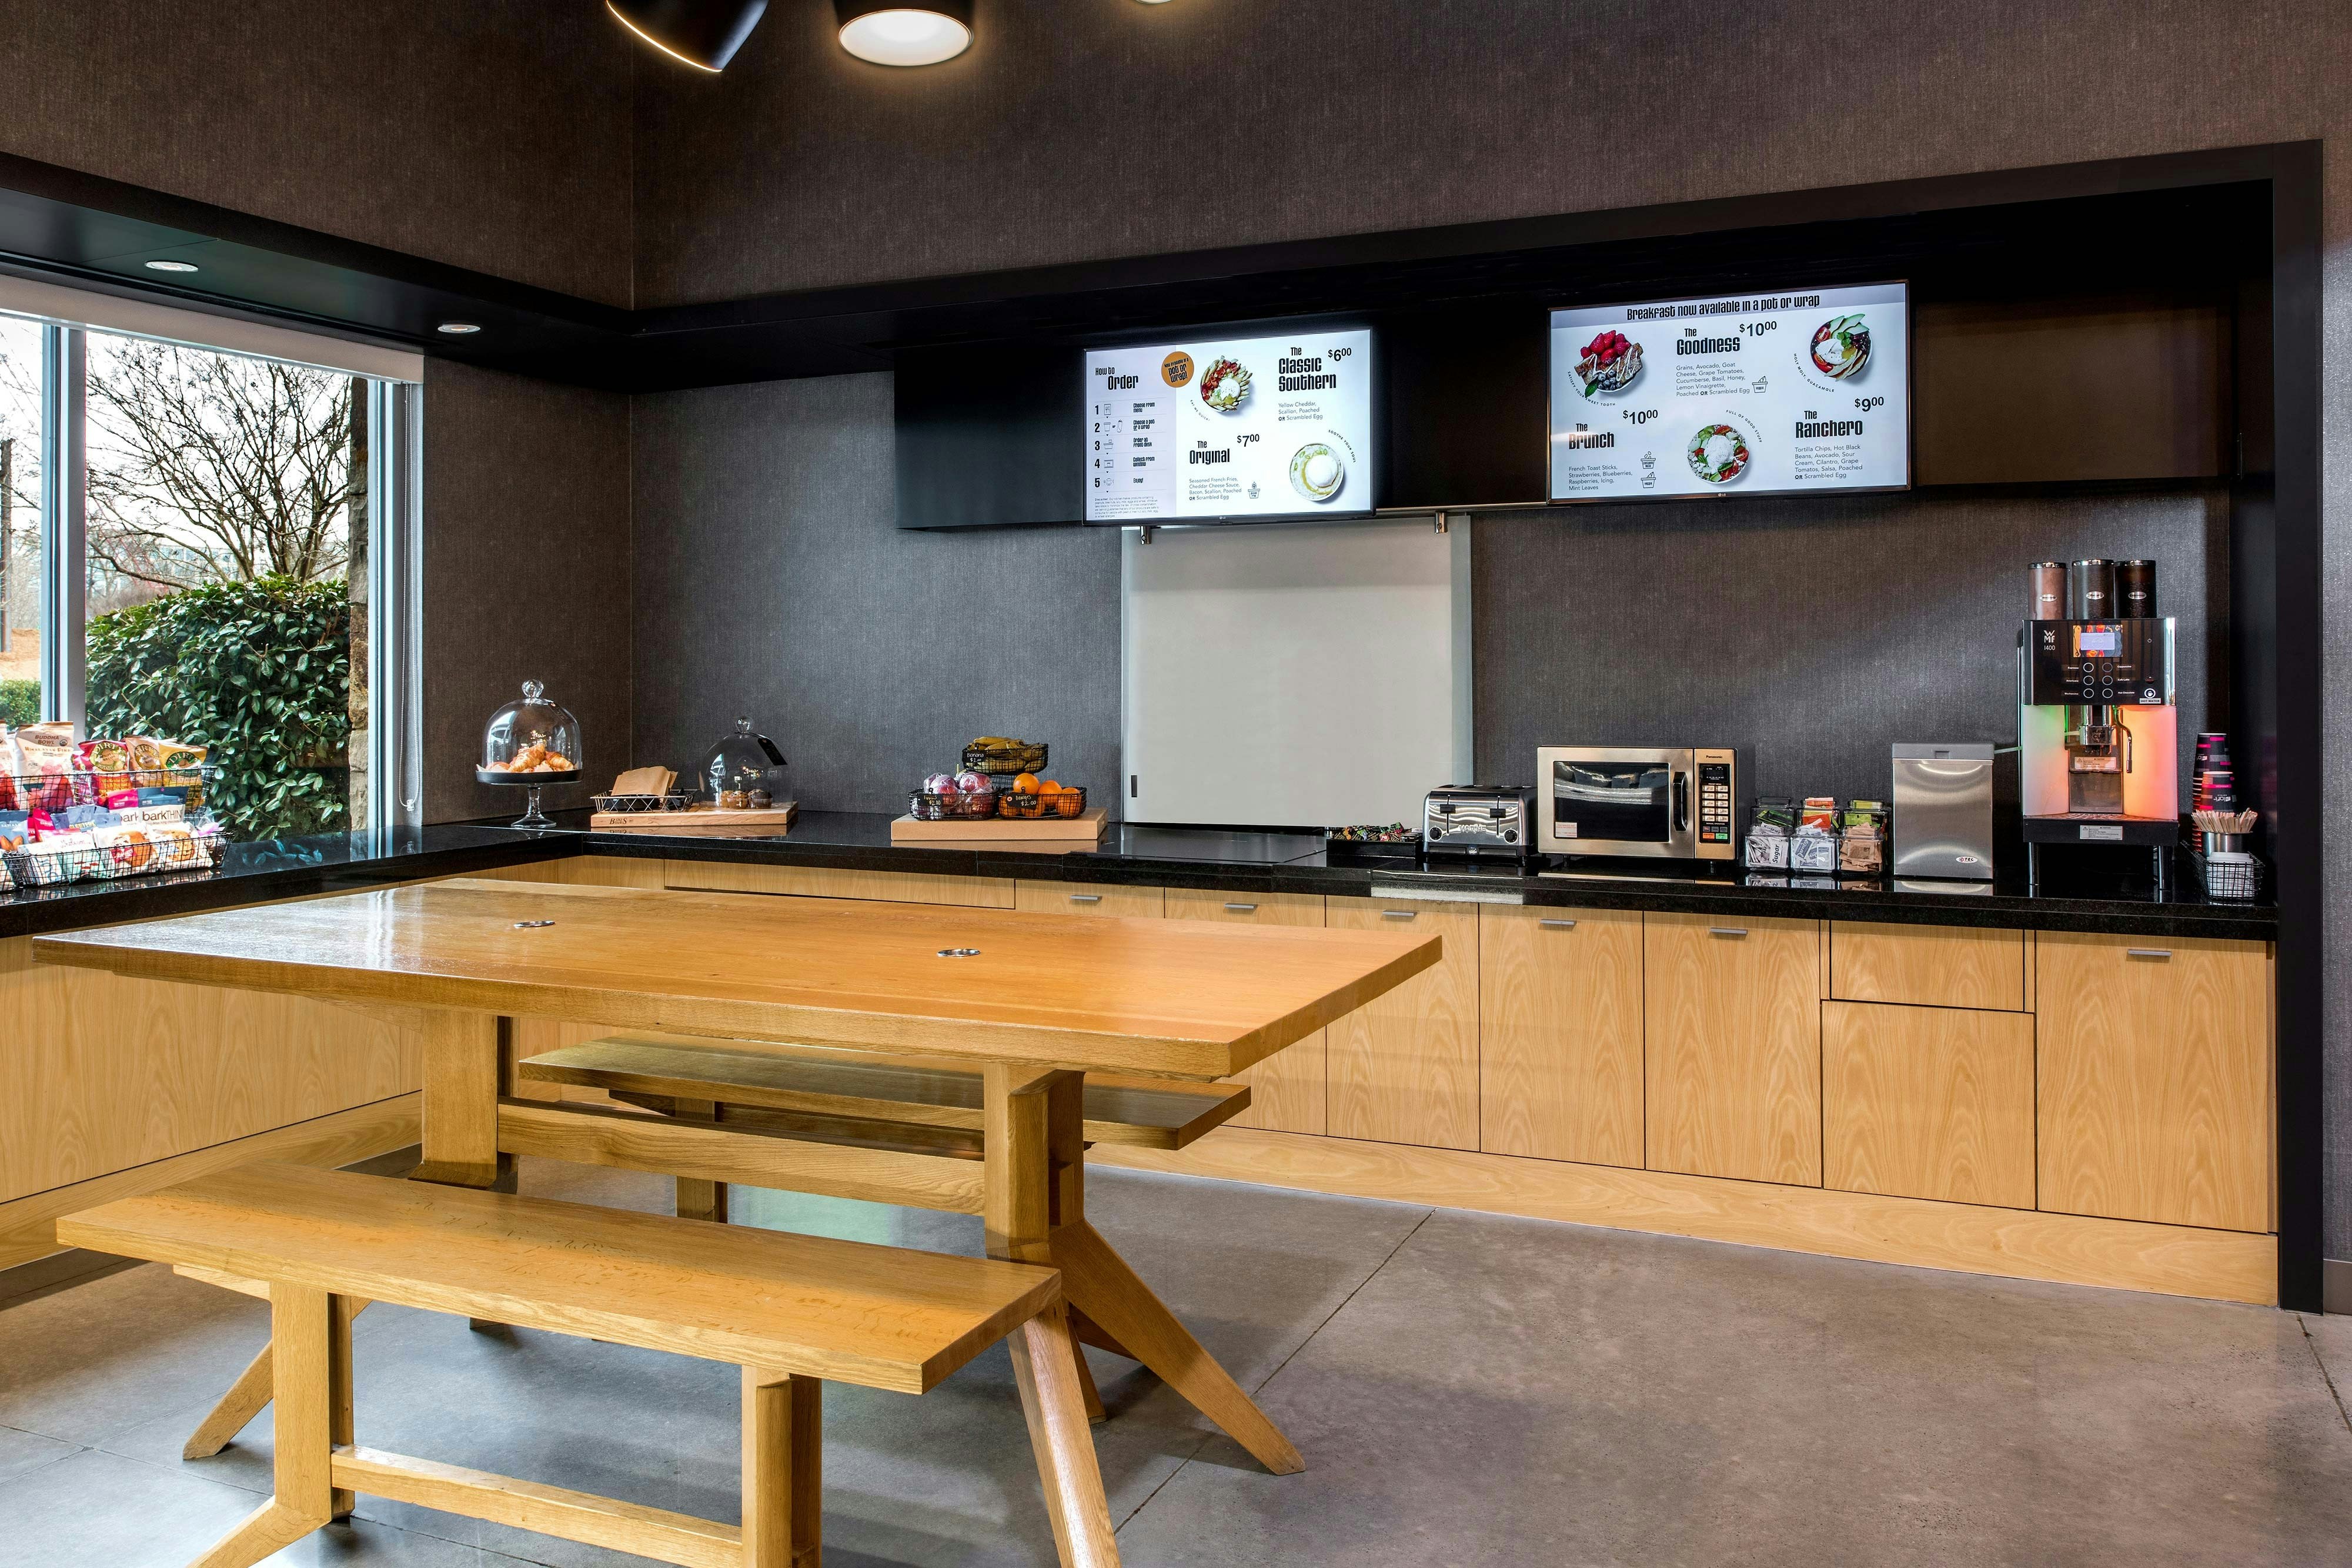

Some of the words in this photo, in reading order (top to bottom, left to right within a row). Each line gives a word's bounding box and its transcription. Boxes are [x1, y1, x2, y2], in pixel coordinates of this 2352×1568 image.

[1627, 305, 1675, 320] Breakfast
[1678, 305, 1696, 317] now
[1699, 300, 1740, 315] available
[1742, 300, 1751, 312] in
[1753, 300, 1759, 310] a
[1760, 297, 1778, 312] pot
[1780, 296, 1792, 309] or
[1794, 295, 1820, 307] wrap
[1685, 328, 1696, 337] The
[1291, 347, 1302, 356] The
[1676, 337, 1740, 356] Goodness
[1095, 367, 1107, 376] How
[1168, 365, 1179, 376] pot
[1180, 363, 1187, 372] or
[1278, 357, 1322, 375] Classic
[1108, 375, 1139, 390] Order
[1170, 370, 1188, 383] wrap!
[1278, 374, 1337, 392] Southern
[1807, 379, 1835, 392] GUACAMOLE
[1095, 404, 1099, 414] 1
[1804, 410, 1817, 420] The
[1094, 422, 1100, 433] 2
[1576, 423, 1588, 432] The
[1745, 418, 1755, 429] GOOD
[1796, 420, 1863, 438] Ranchero
[1094, 440, 1100, 450] 3
[1569, 432, 1615, 449] Brunch
[1190, 448, 1230, 465] Original
[1094, 459, 1100, 469] 4
[1094, 477, 1100, 487] 5
[92, 742, 126, 755] DIRTY
[1772, 844, 1780, 864] Sugar
